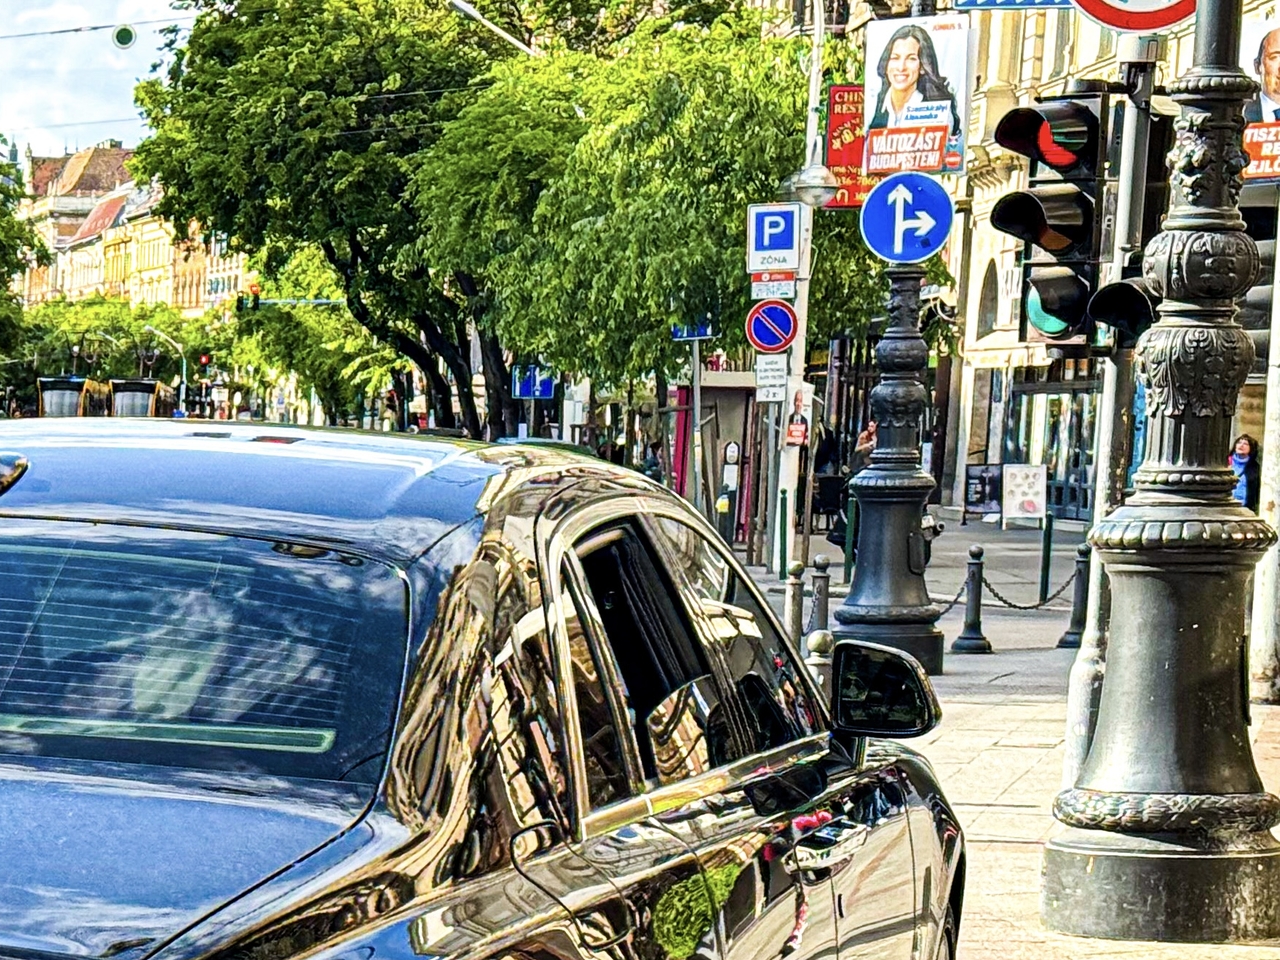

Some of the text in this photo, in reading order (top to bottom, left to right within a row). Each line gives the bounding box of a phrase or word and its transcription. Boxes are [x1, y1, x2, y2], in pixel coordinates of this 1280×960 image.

[872, 127, 944, 153] VÁLTOZÁST
[869, 151, 940, 170] BUDAPESTEN!
[763, 216, 785, 246] P
[761, 255, 787, 265] ZÓNA
